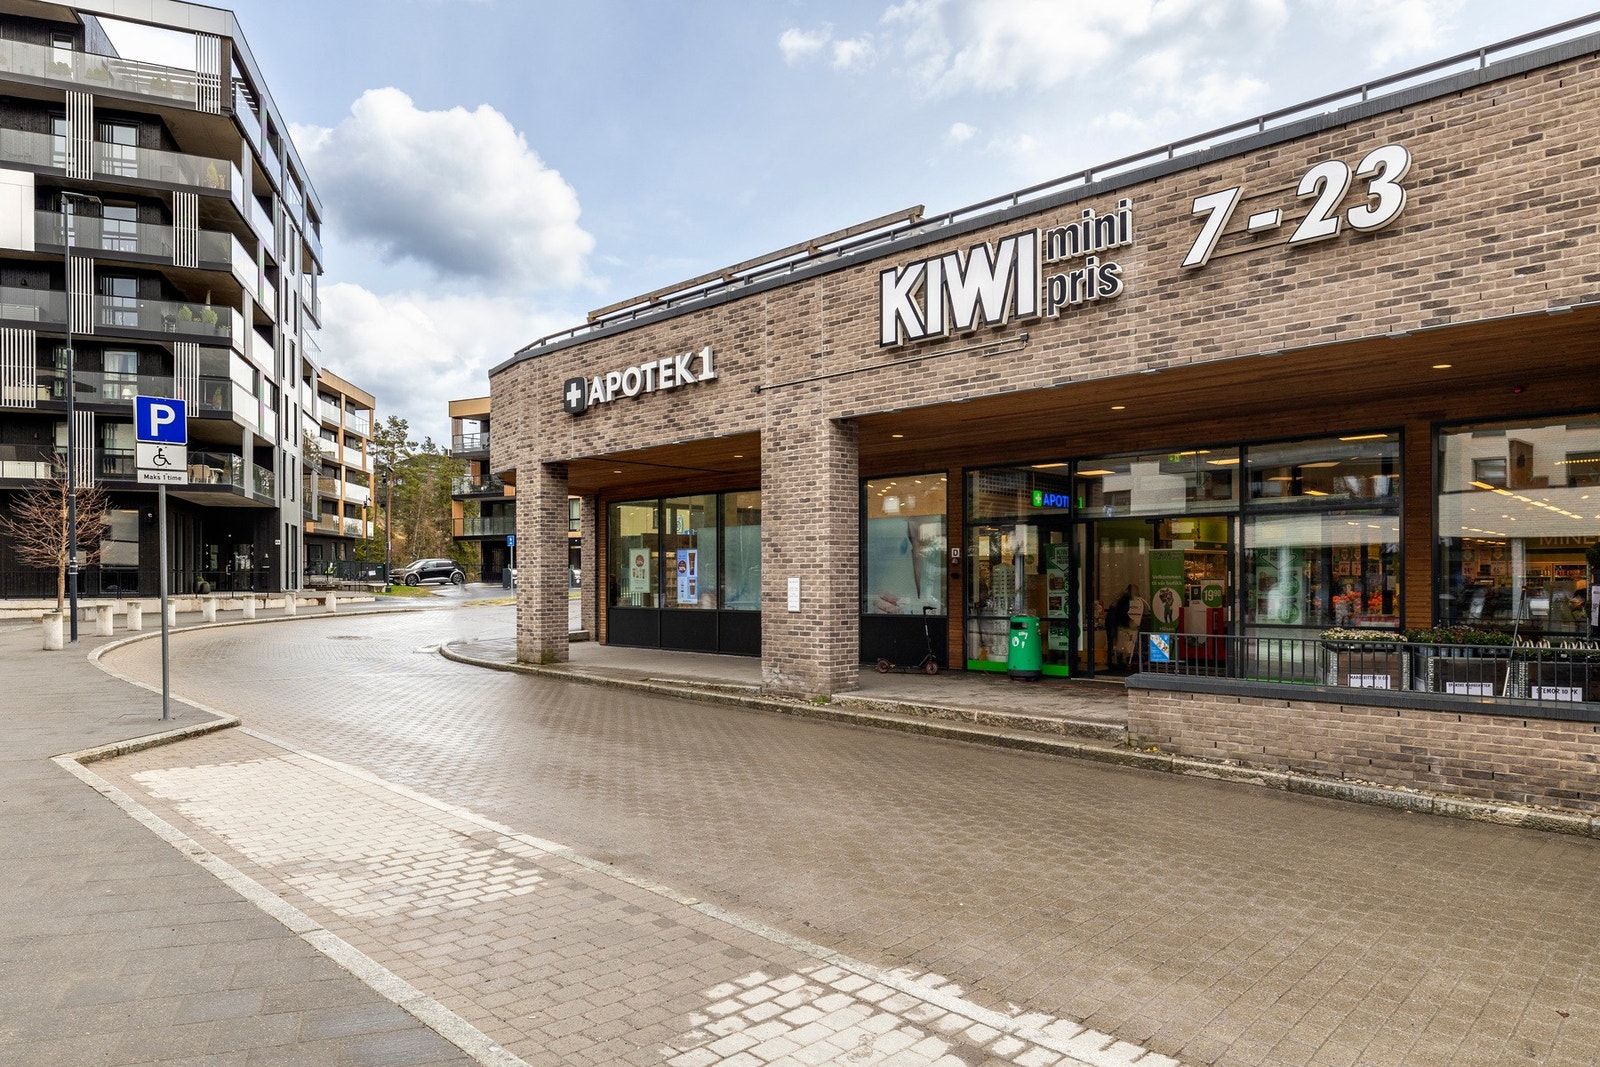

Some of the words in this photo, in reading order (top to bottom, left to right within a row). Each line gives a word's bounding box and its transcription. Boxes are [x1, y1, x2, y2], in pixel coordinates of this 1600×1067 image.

[1046, 198, 1132, 262] mini
[879, 227, 1042, 348] KIWI
[1046, 256, 1123, 318] pris
[150, 403, 176, 437] P
[143, 473, 161, 481] Maks
[1043, 493, 1069, 509] APOT
[1535, 687, 1560, 695] SEMOR
